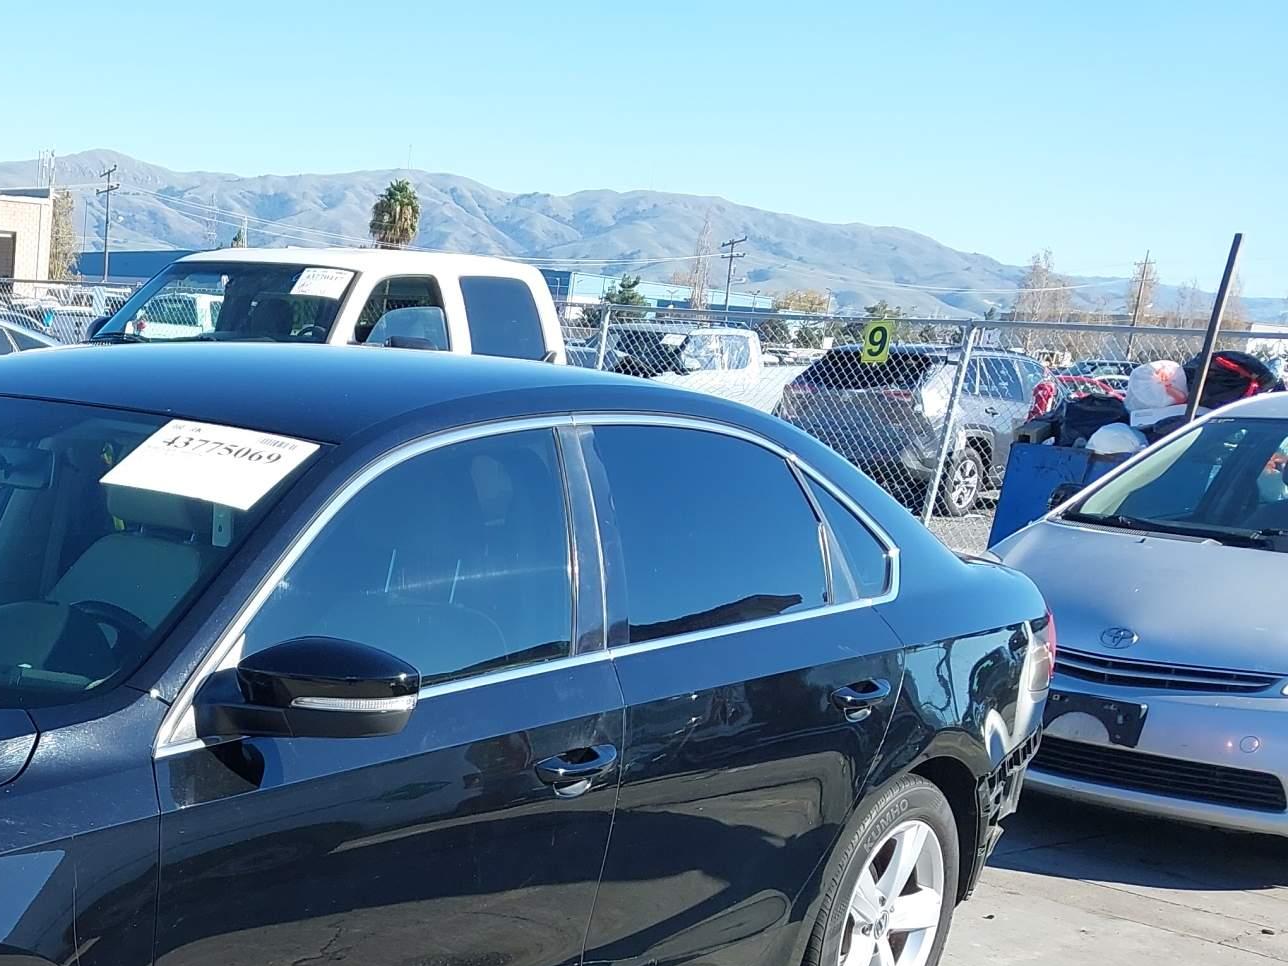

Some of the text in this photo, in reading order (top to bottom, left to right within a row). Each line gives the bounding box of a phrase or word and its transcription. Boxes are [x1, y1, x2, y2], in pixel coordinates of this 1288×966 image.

[867, 326, 888, 357] 9
[162, 434, 283, 465] 43775069
[863, 798, 909, 854] KUMHO
